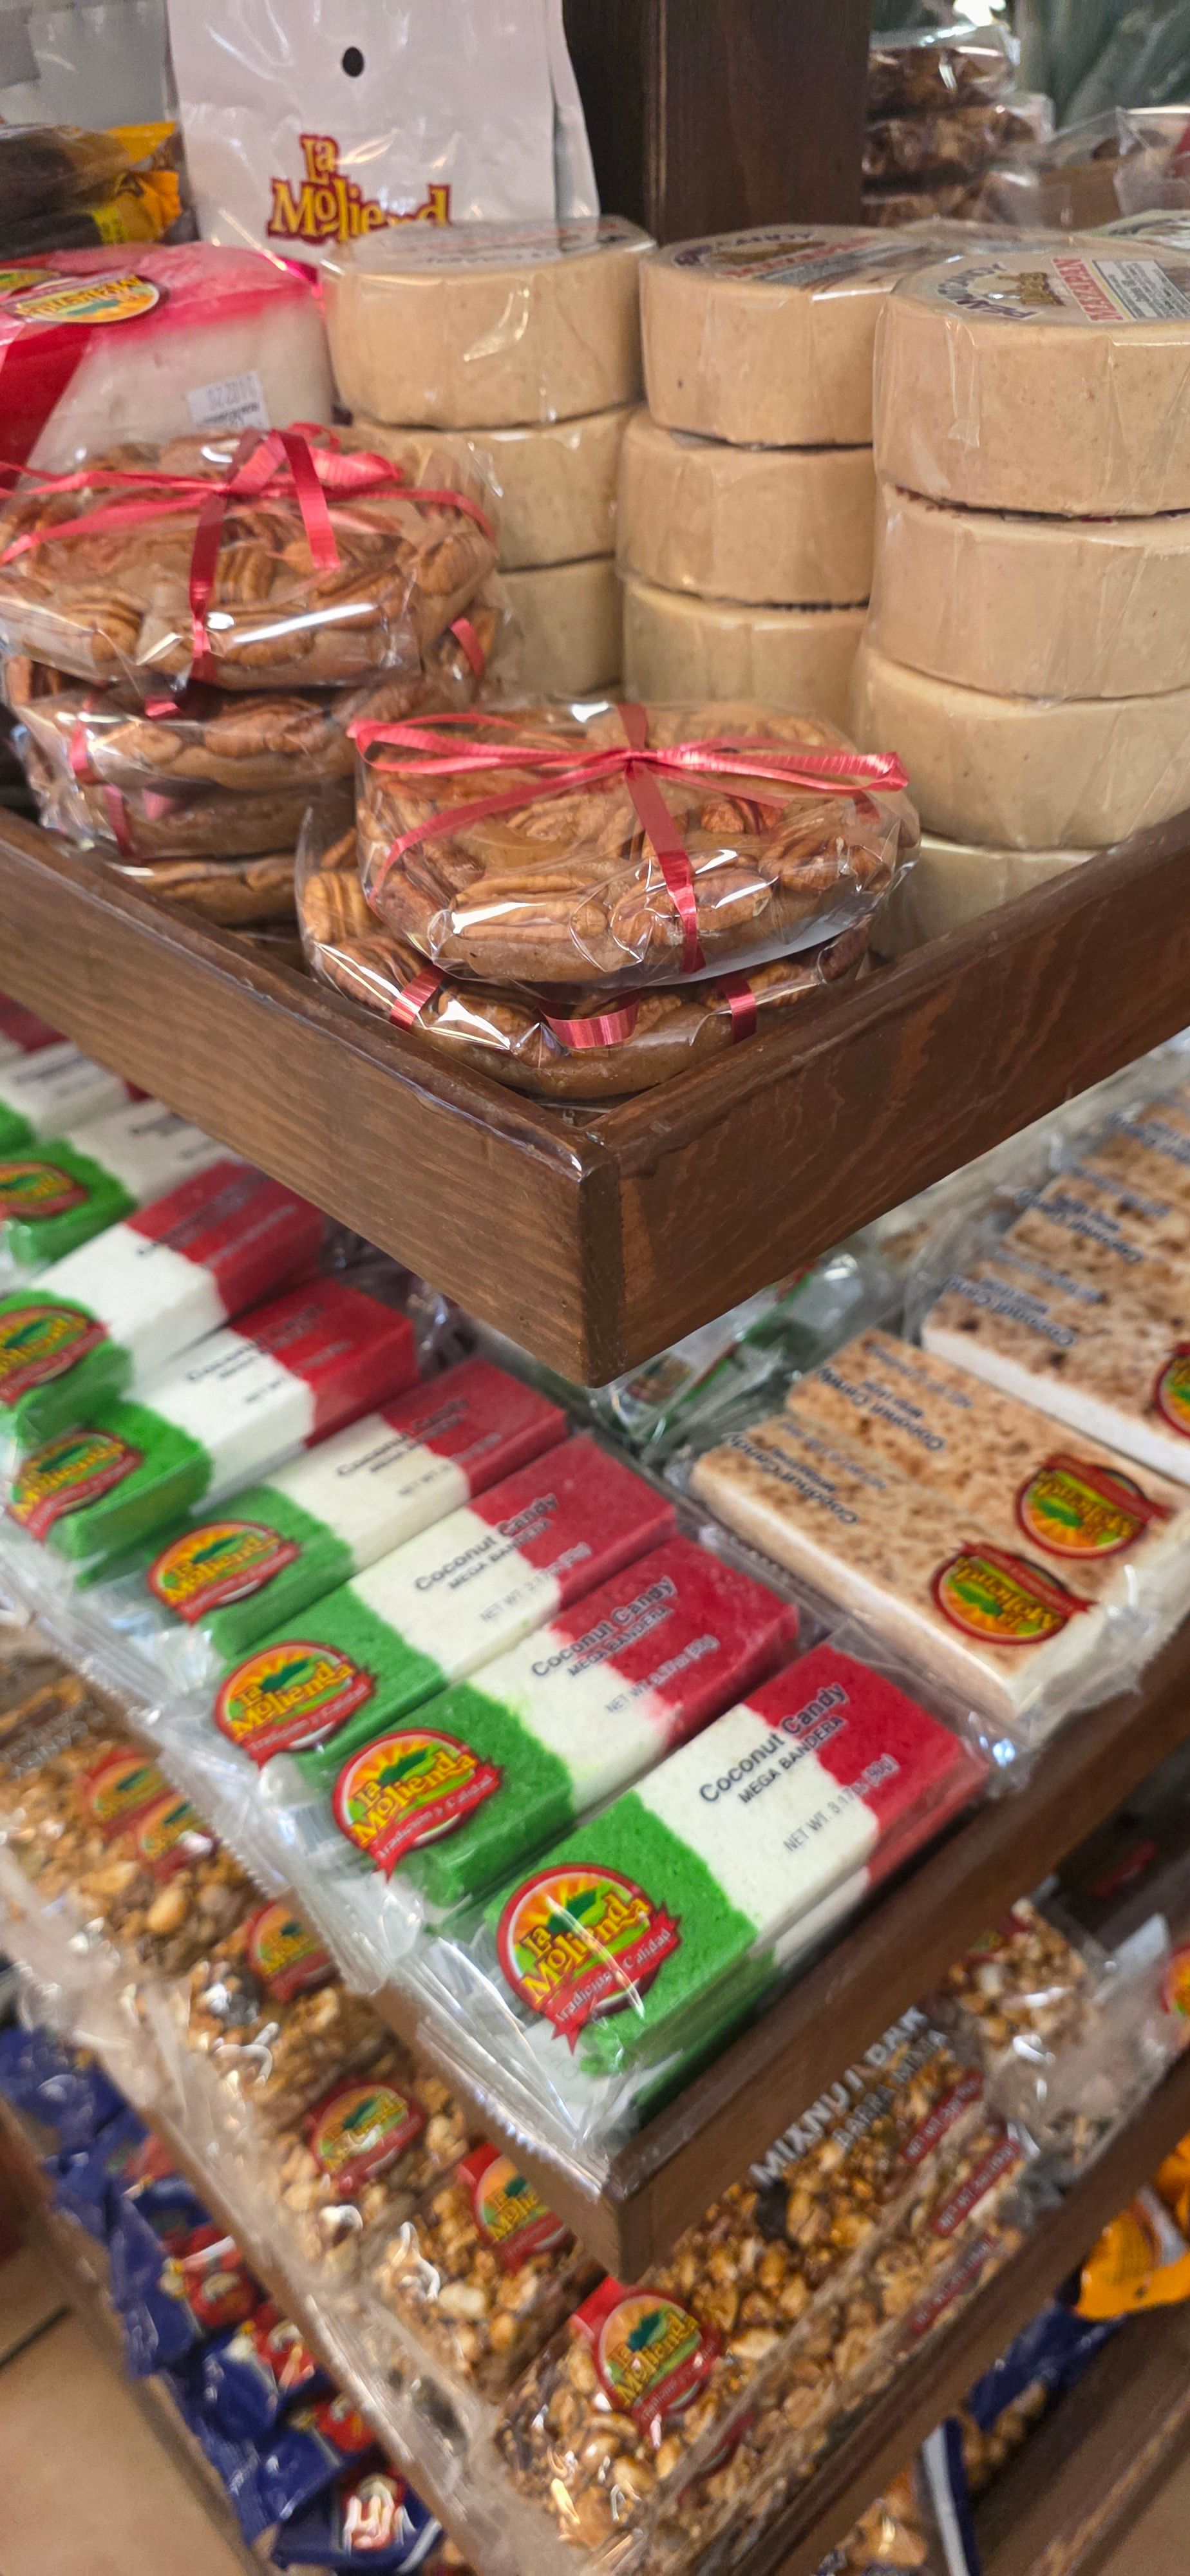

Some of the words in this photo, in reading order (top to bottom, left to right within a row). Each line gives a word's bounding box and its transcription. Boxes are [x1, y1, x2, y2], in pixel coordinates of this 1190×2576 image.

[300, 133, 339, 185] La
[415, 1537, 496, 1590] Coconut
[498, 1495, 558, 1537] Candy
[531, 1622, 614, 1676] Coconut
[613, 1577, 675, 1625] Candy
[567, 1648, 609, 1677] MEGA
[607, 1605, 670, 1653] BANDERA
[231, 1662, 355, 1743] Molienda
[605, 1694, 629, 1712] NET
[699, 1732, 786, 1803] Coconut
[781, 1682, 848, 1735] Candy
[739, 1768, 781, 1804] MEGA
[778, 1716, 845, 1770] BANDERA
[351, 1750, 477, 1849] Molienda
[355, 1780, 382, 1808] La
[782, 1827, 810, 1853] NET
[520, 1926, 552, 1958] La
